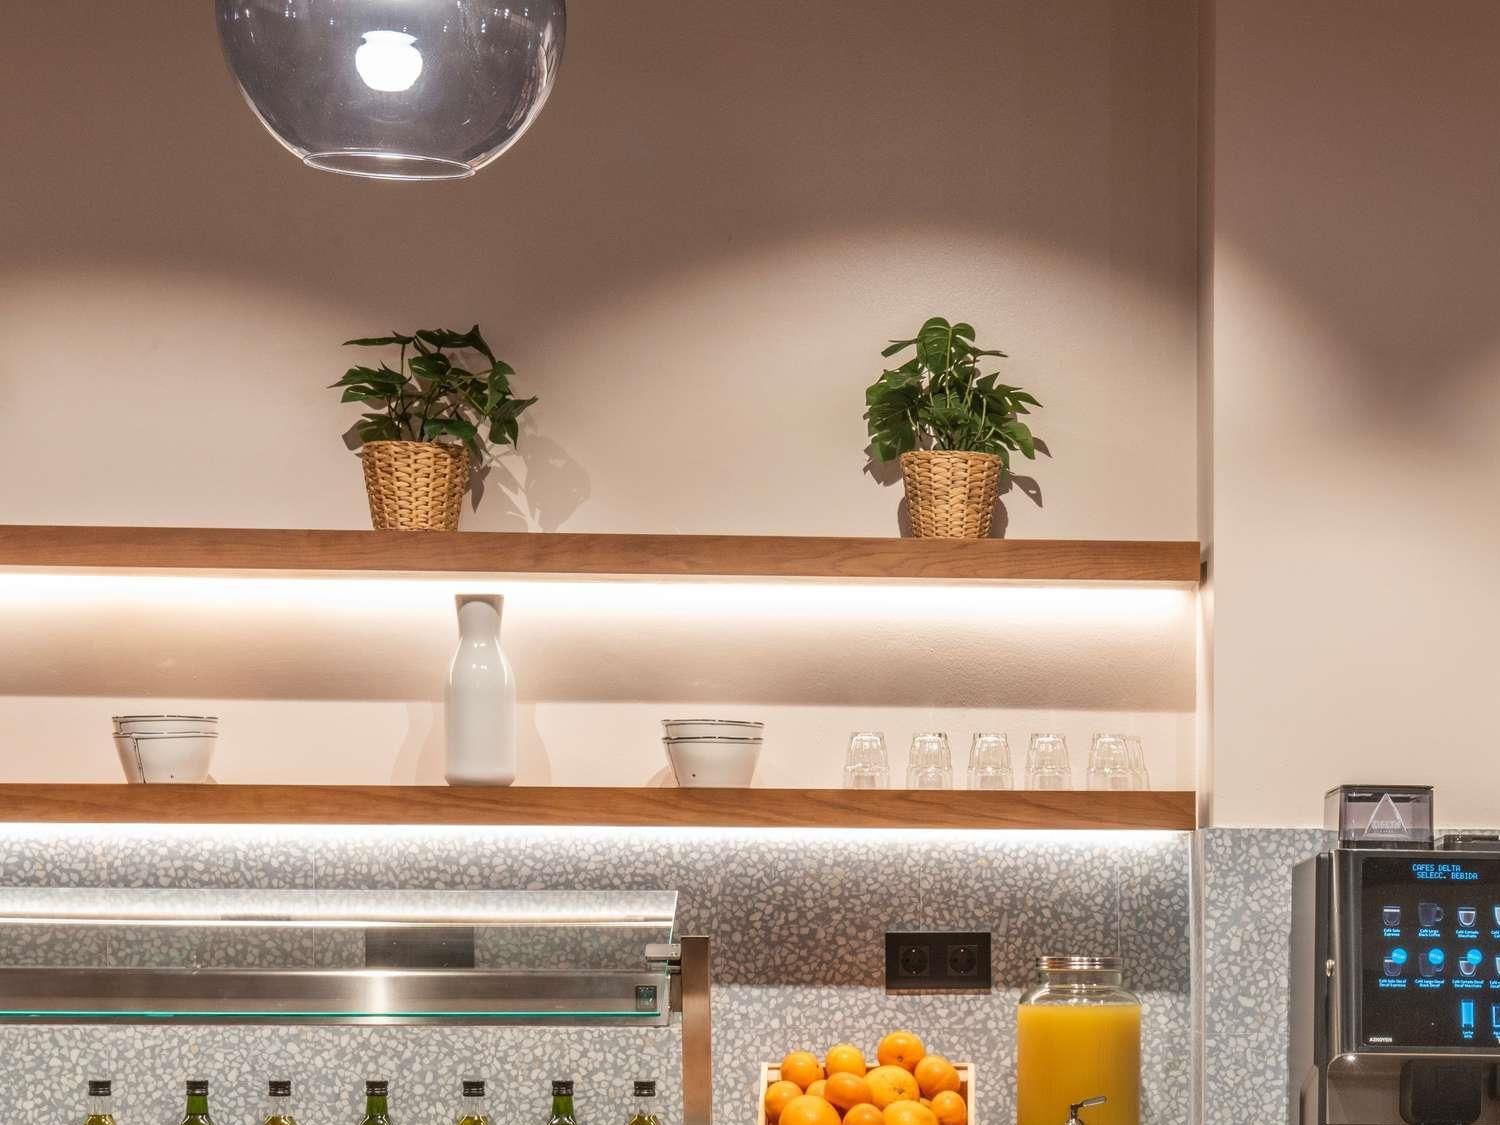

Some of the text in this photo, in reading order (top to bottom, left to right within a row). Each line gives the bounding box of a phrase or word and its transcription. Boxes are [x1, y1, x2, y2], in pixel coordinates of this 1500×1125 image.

[1412, 863, 1461, 872] CAFES DELTA
[1451, 872, 1478, 880] BEBIDA
